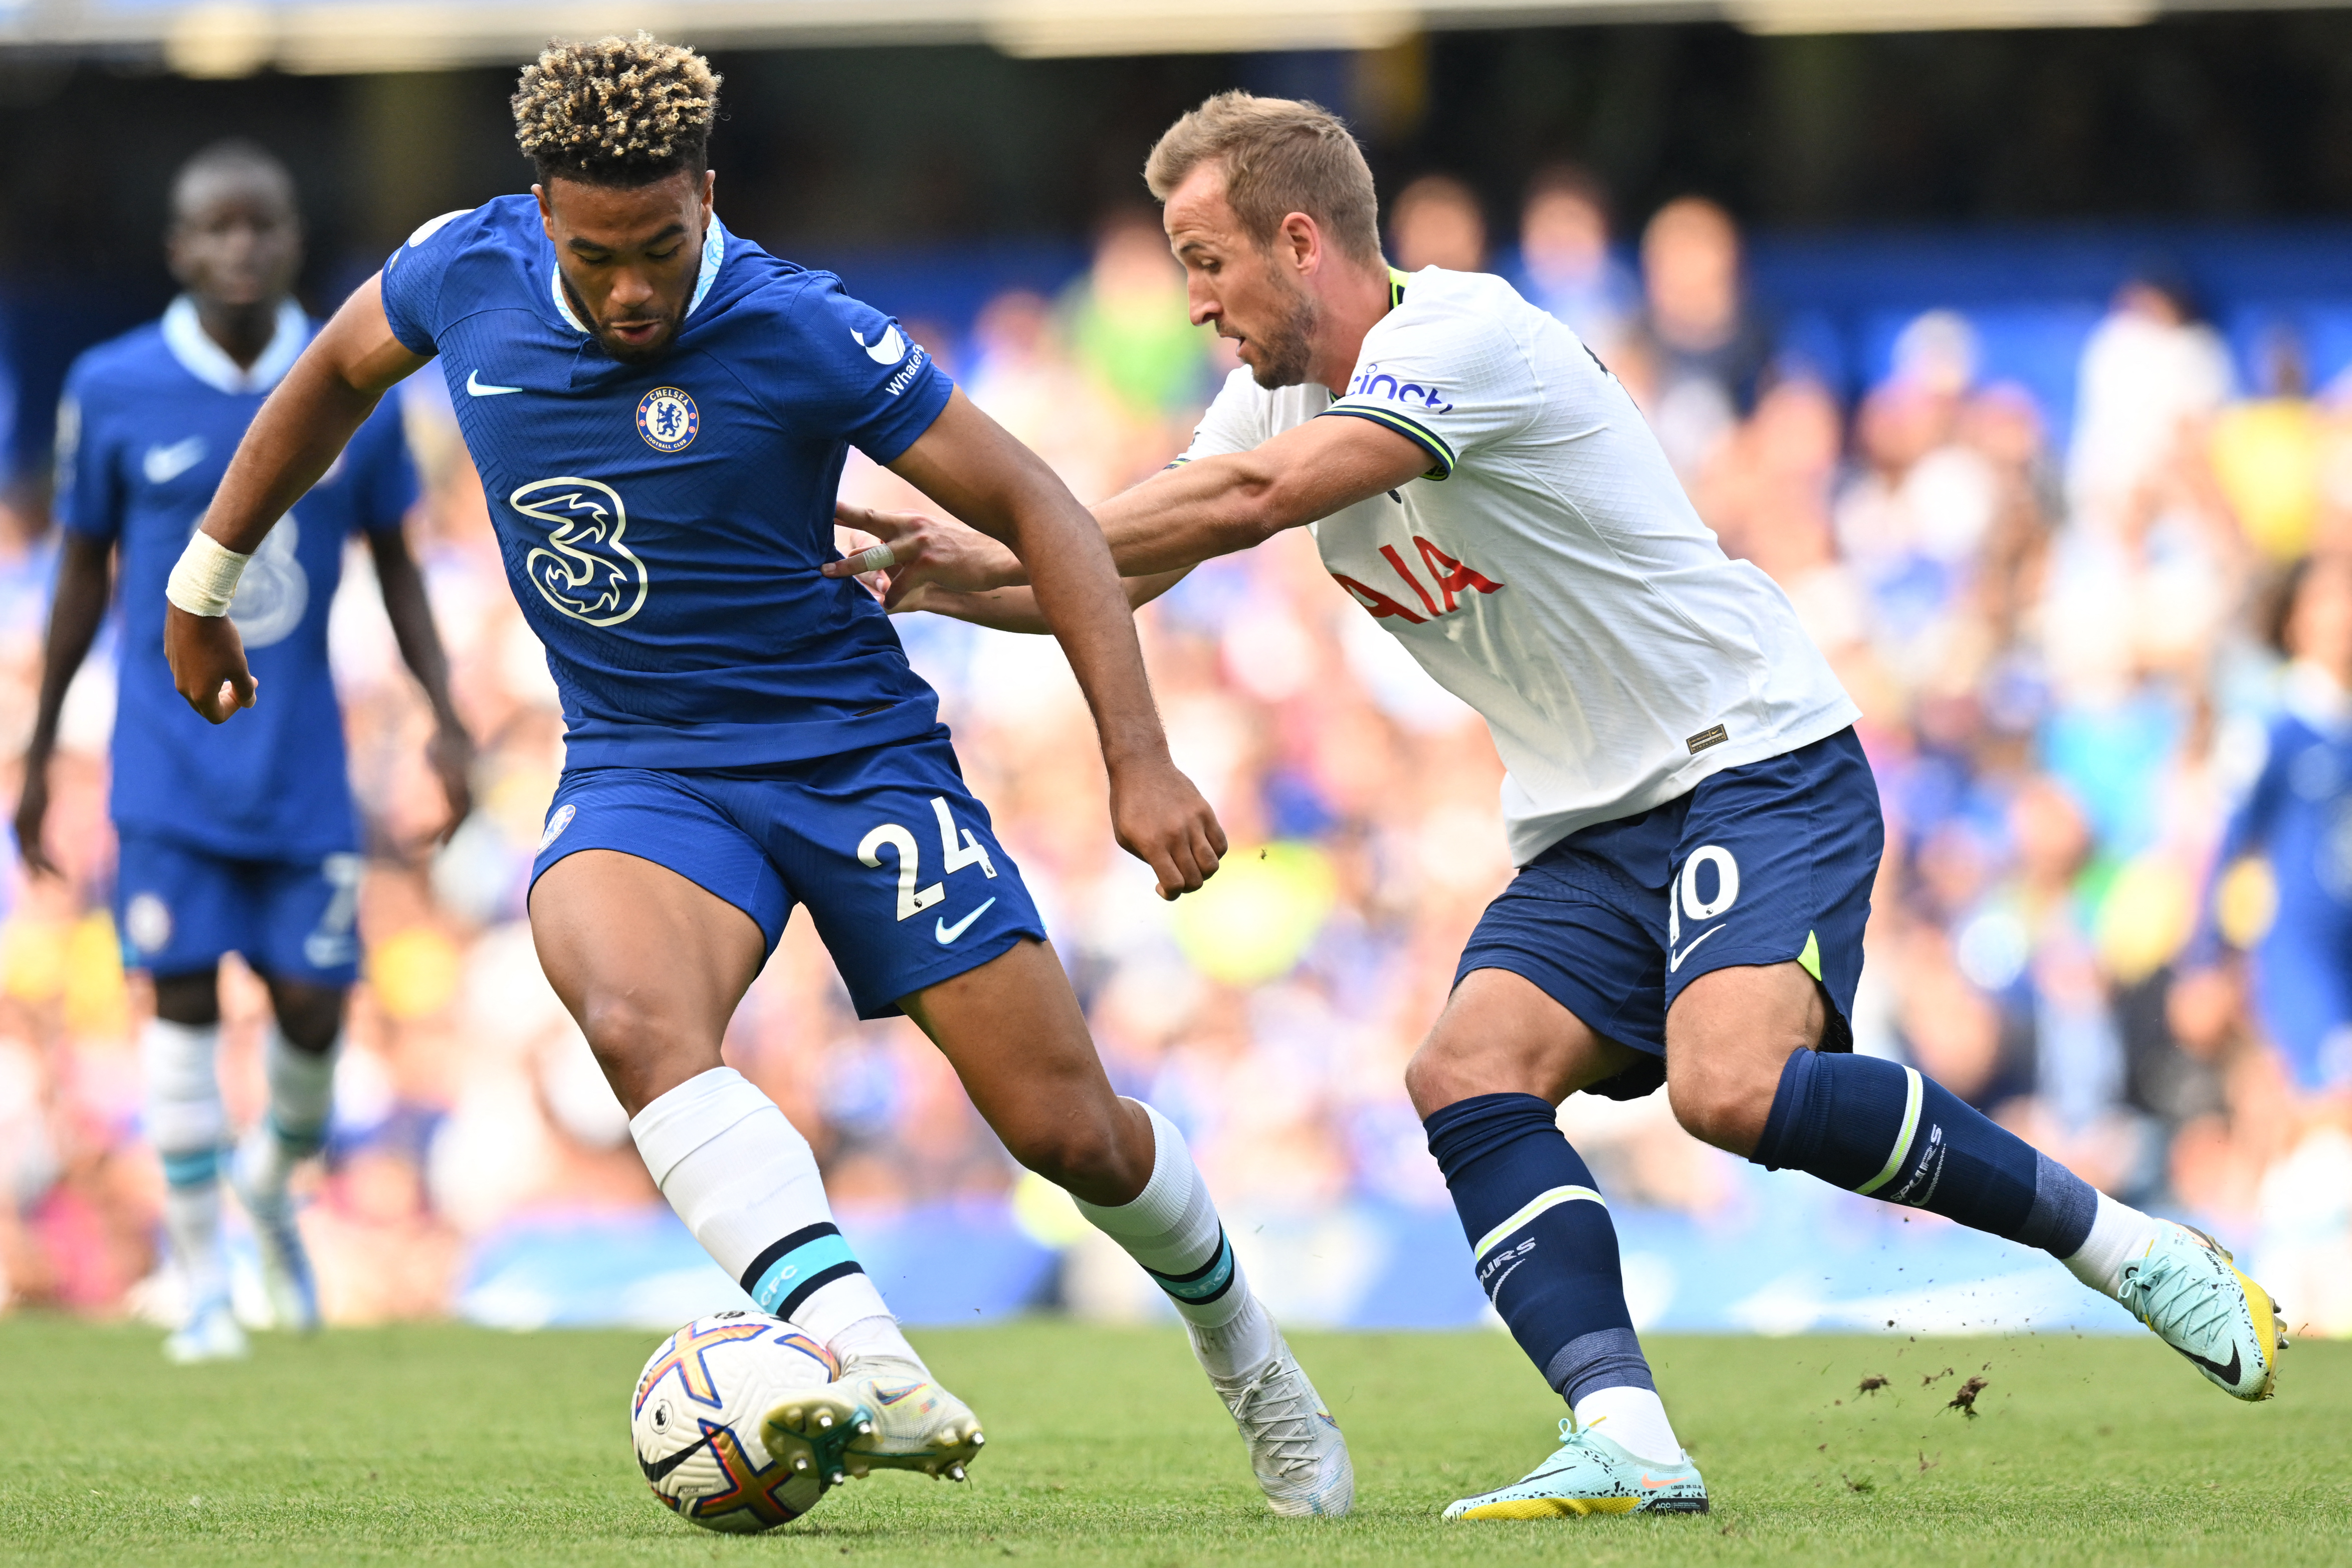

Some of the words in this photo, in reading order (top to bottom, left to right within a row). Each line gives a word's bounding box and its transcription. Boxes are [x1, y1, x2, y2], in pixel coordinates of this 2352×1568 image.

[650, 389, 689, 406] CHELSEA
[646, 434, 672, 449] FOOTBALL
[673, 438, 687, 448] CLUB
[1330, 535, 1506, 624] AIA
[857, 796, 998, 922] 24
[1889, 1123, 1942, 1202] SPURS
[761, 1264, 798, 1306] CFC
